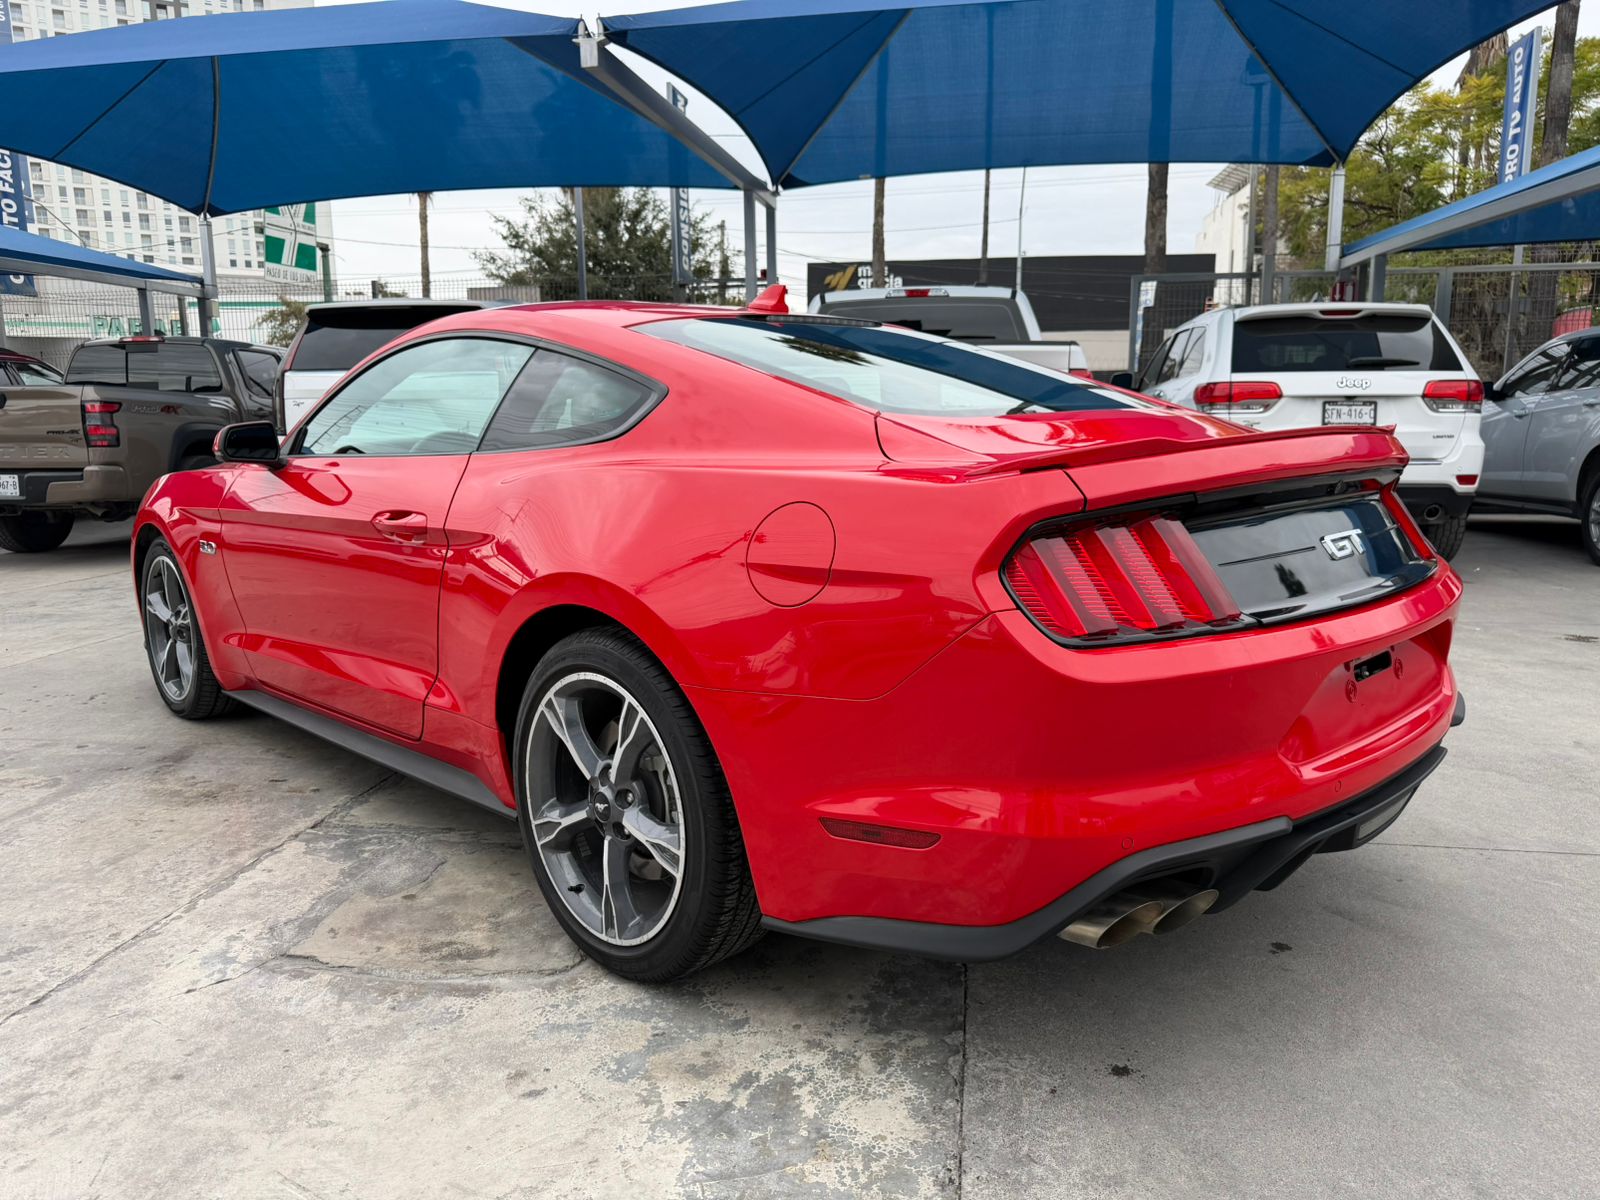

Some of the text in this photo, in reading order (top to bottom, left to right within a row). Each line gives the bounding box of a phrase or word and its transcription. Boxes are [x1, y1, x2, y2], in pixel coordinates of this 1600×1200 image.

[1513, 47, 1523, 103] AUTO
[1337, 376, 1371, 390] Jeep
[1319, 529, 1366, 561] GT
